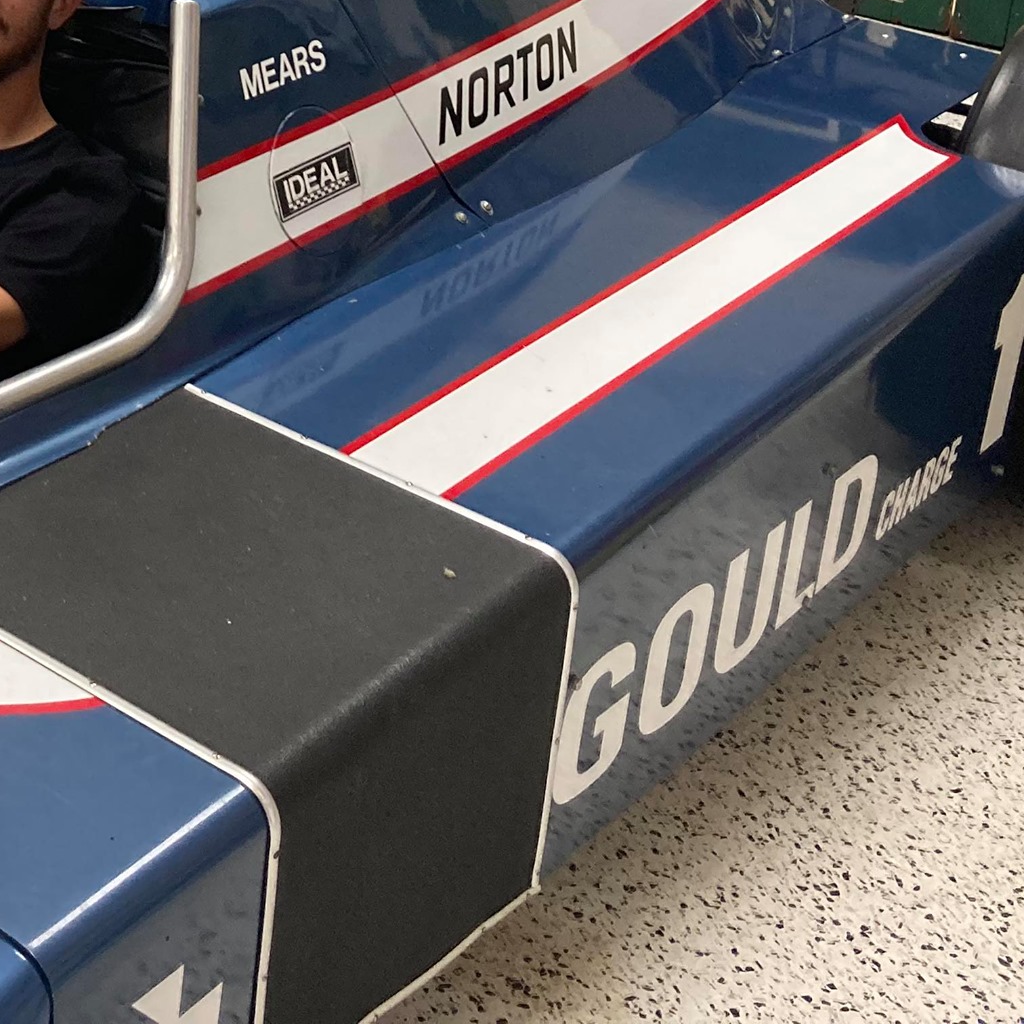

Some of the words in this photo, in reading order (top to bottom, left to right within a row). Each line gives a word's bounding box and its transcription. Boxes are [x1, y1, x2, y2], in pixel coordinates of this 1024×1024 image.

[239, 39, 327, 100] MEARS
[438, 20, 578, 146] NORTON
[283, 156, 349, 202] IDEAL
[551, 454, 879, 805] GOULD
[874, 435, 963, 541] CHARGE
